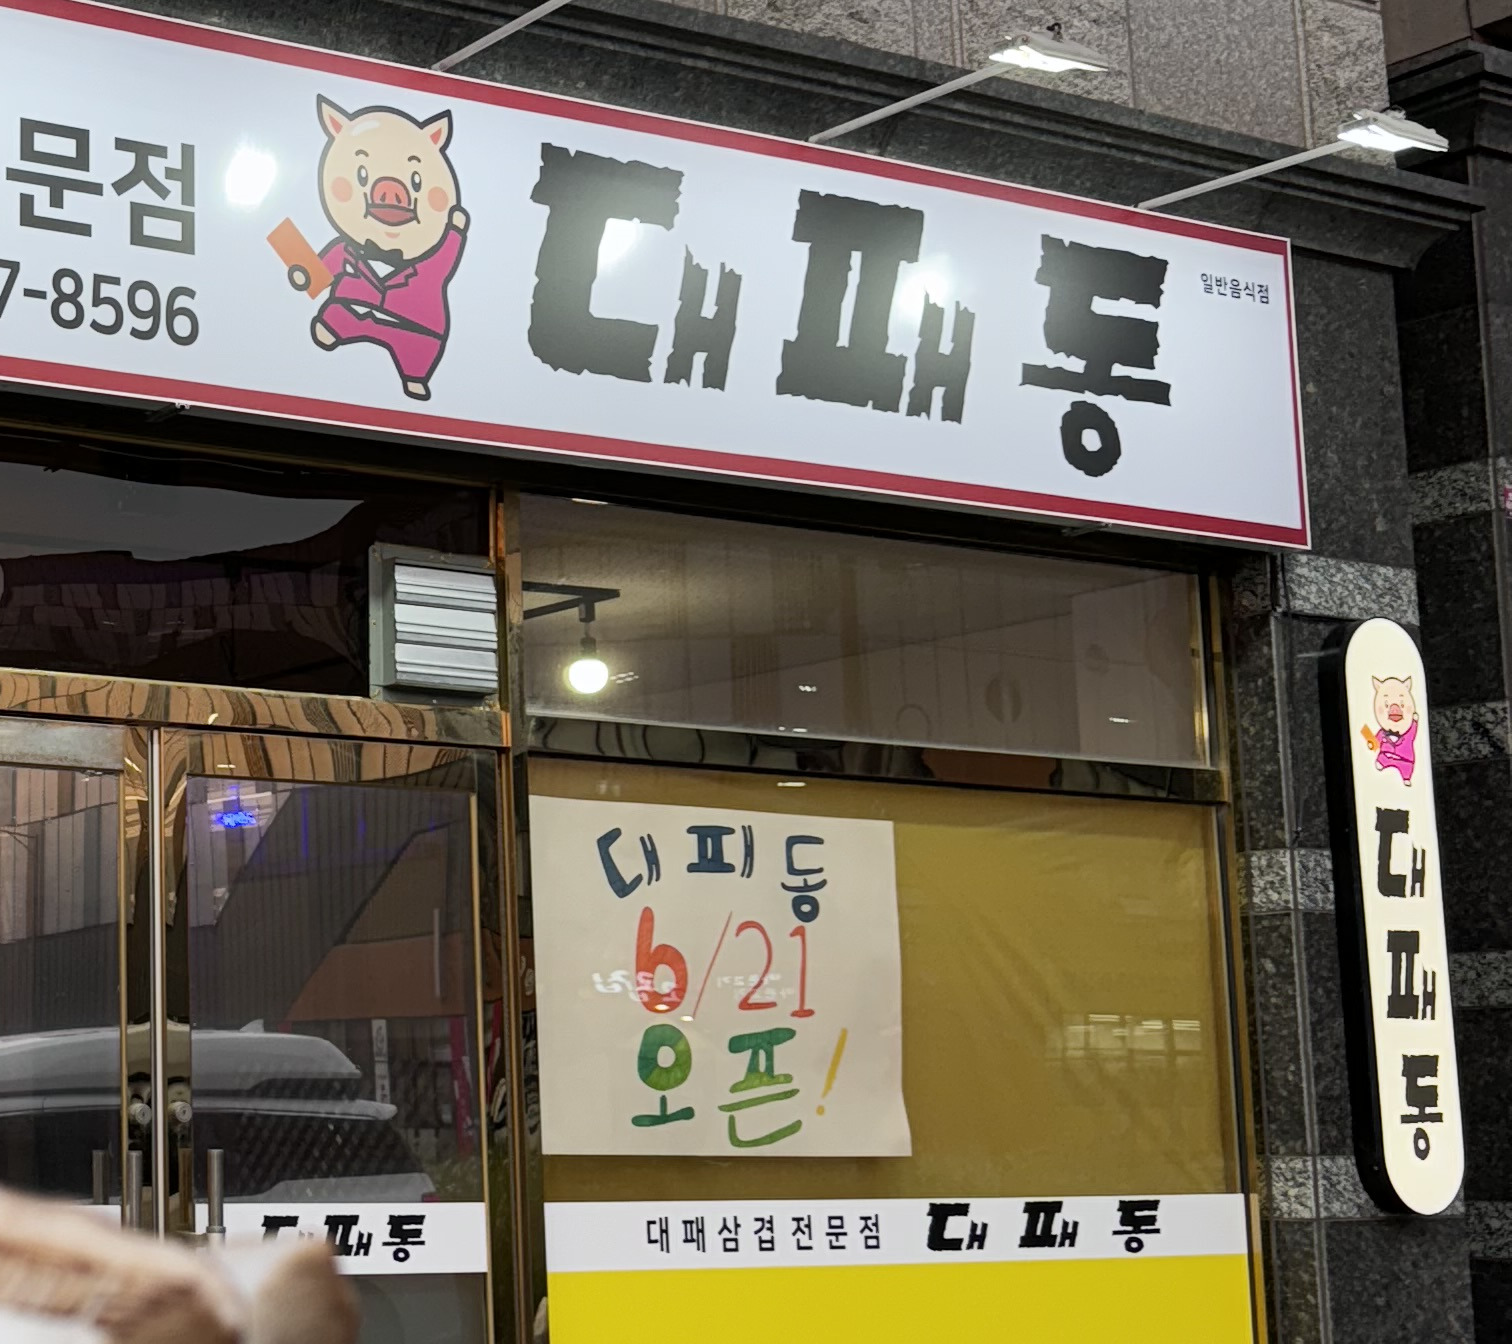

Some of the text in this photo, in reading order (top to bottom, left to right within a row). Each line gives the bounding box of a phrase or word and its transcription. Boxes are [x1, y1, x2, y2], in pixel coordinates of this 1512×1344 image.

[526, 142, 1172, 478] 대패동
[1200, 272, 1270, 305] 일반음식점
[597, 825, 827, 923] 대패동
[635, 906, 815, 1020] 6/21
[1375, 807, 1443, 1161] 대패동
[631, 1023, 848, 1148] 오픈!
[927, 1199, 1162, 1254] 대패동
